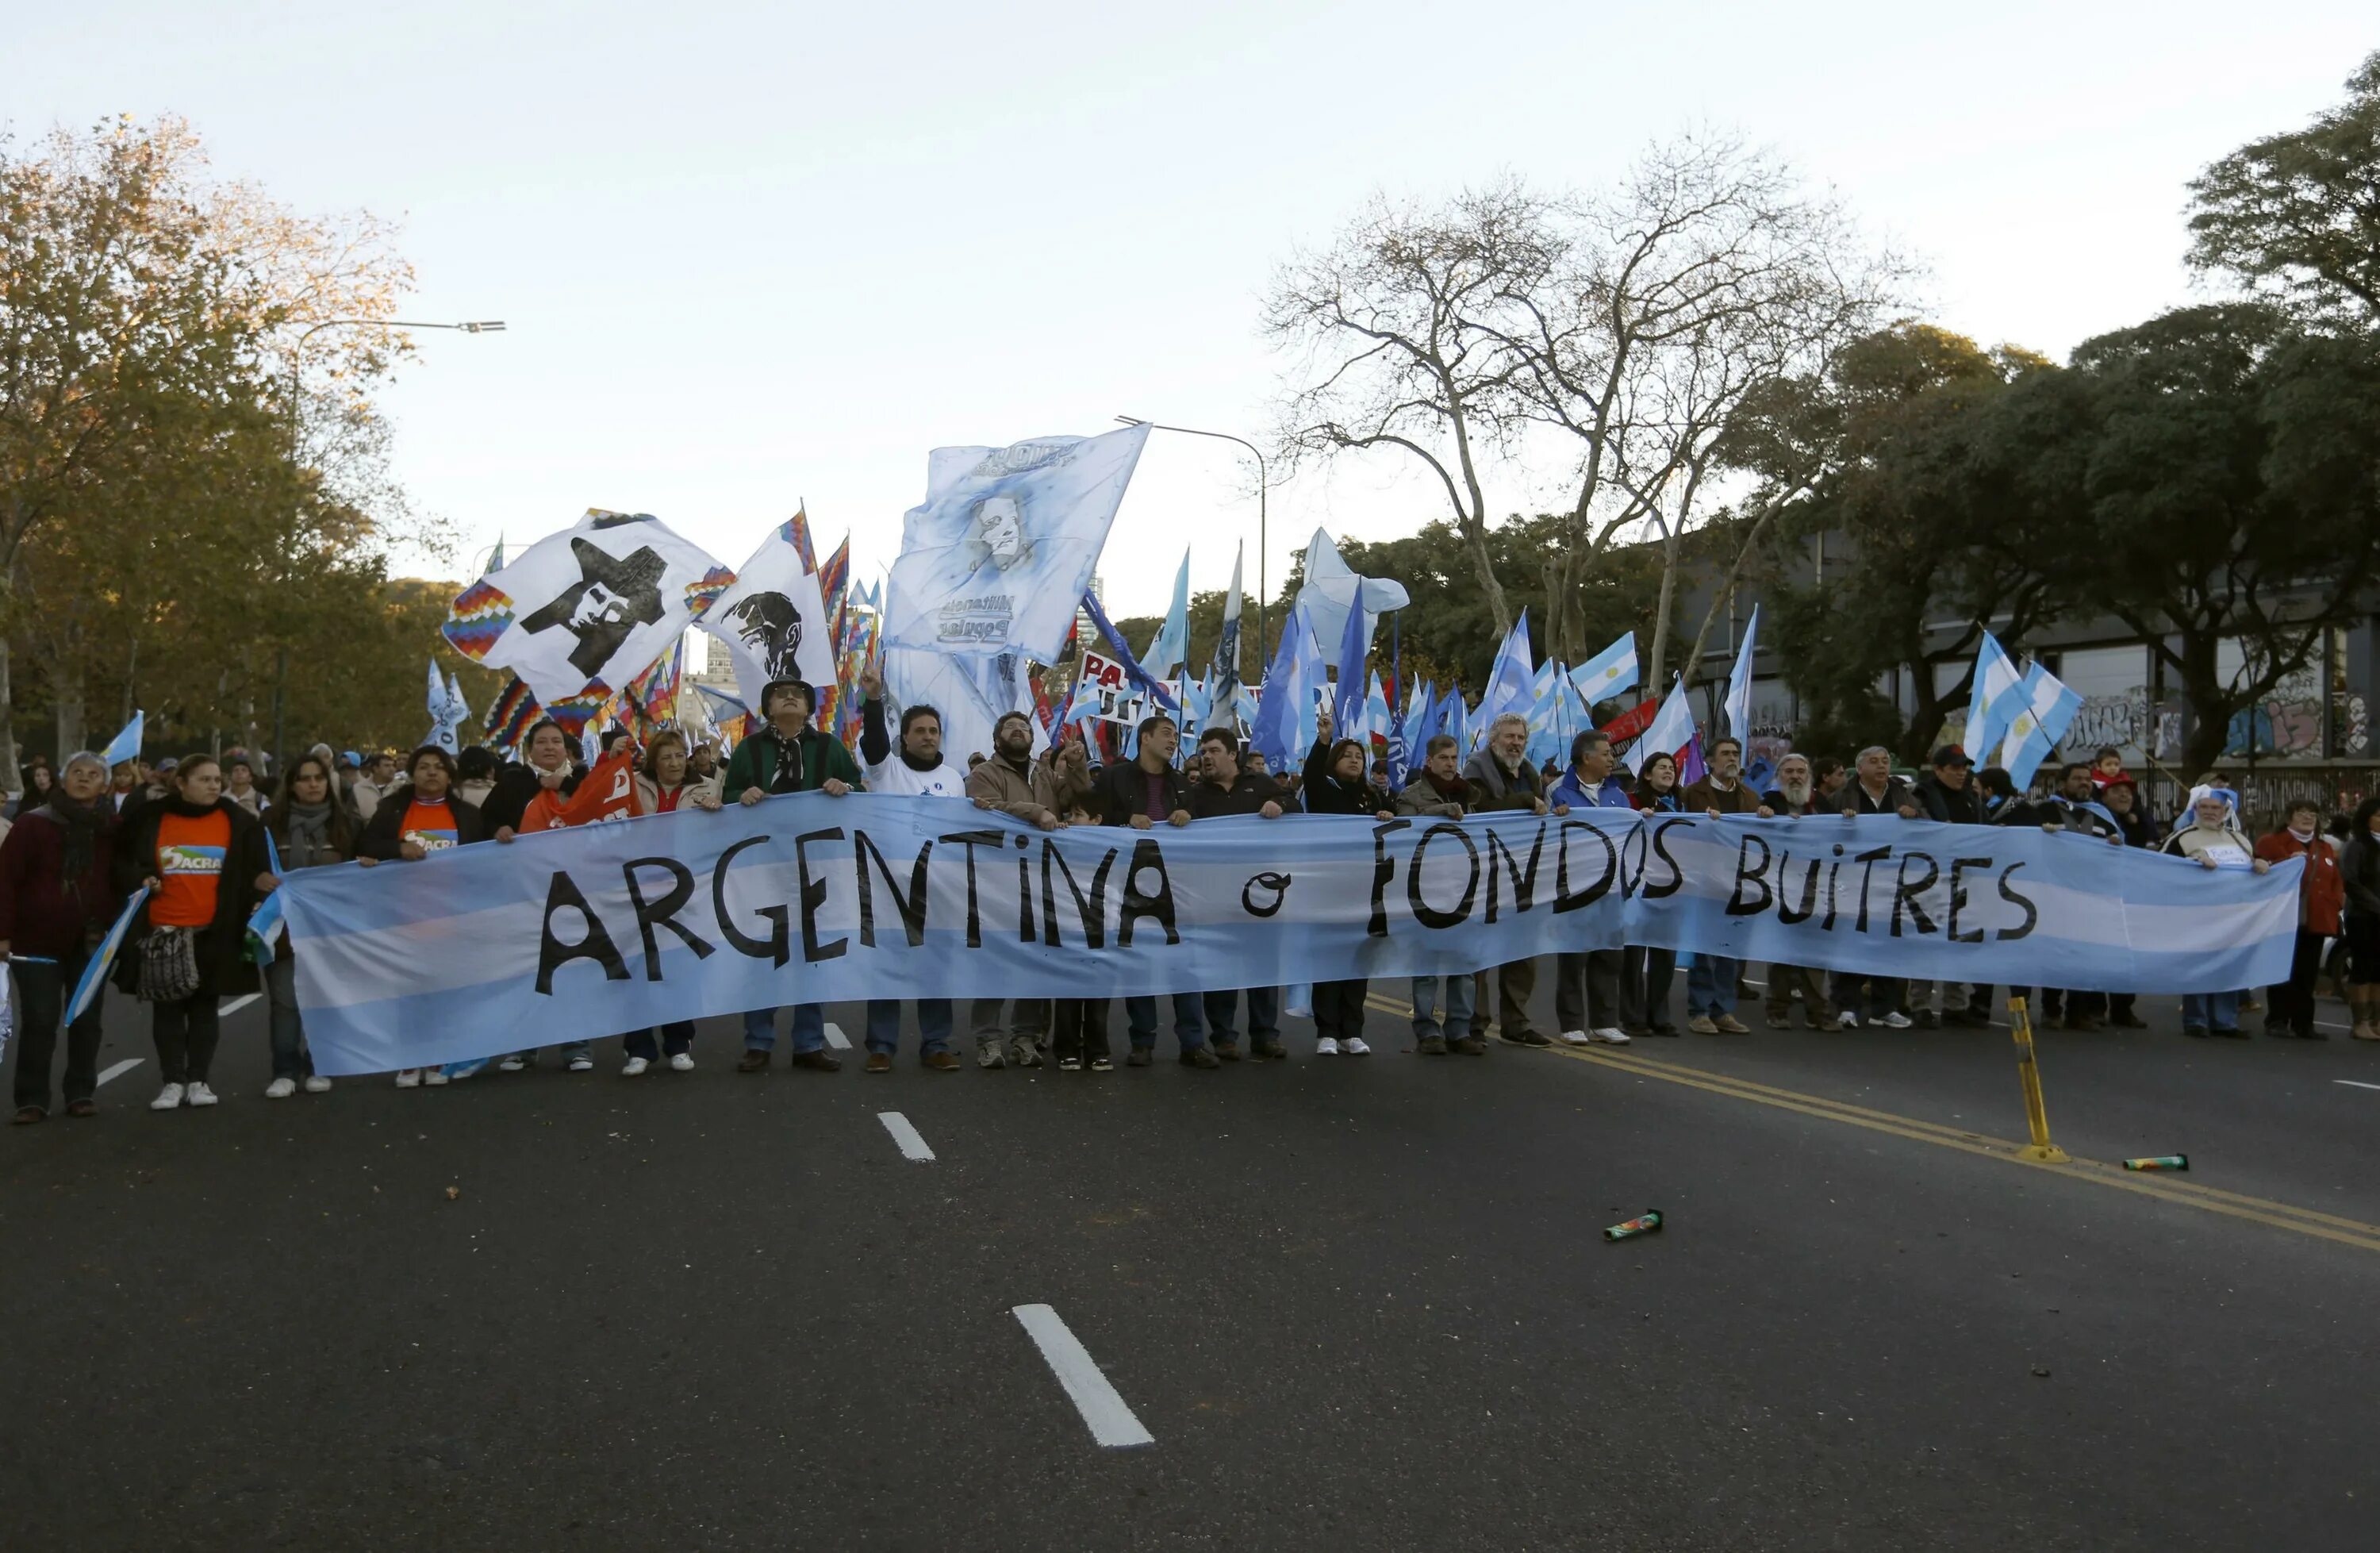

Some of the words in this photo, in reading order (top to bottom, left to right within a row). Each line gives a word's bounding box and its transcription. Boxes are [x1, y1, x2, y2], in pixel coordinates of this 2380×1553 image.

[159, 845, 222, 870] SACRA
[535, 826, 1179, 996] ARGENTiNA
[1367, 818, 1696, 937] FONDOS
[1726, 834, 2036, 942] BUiTRES
